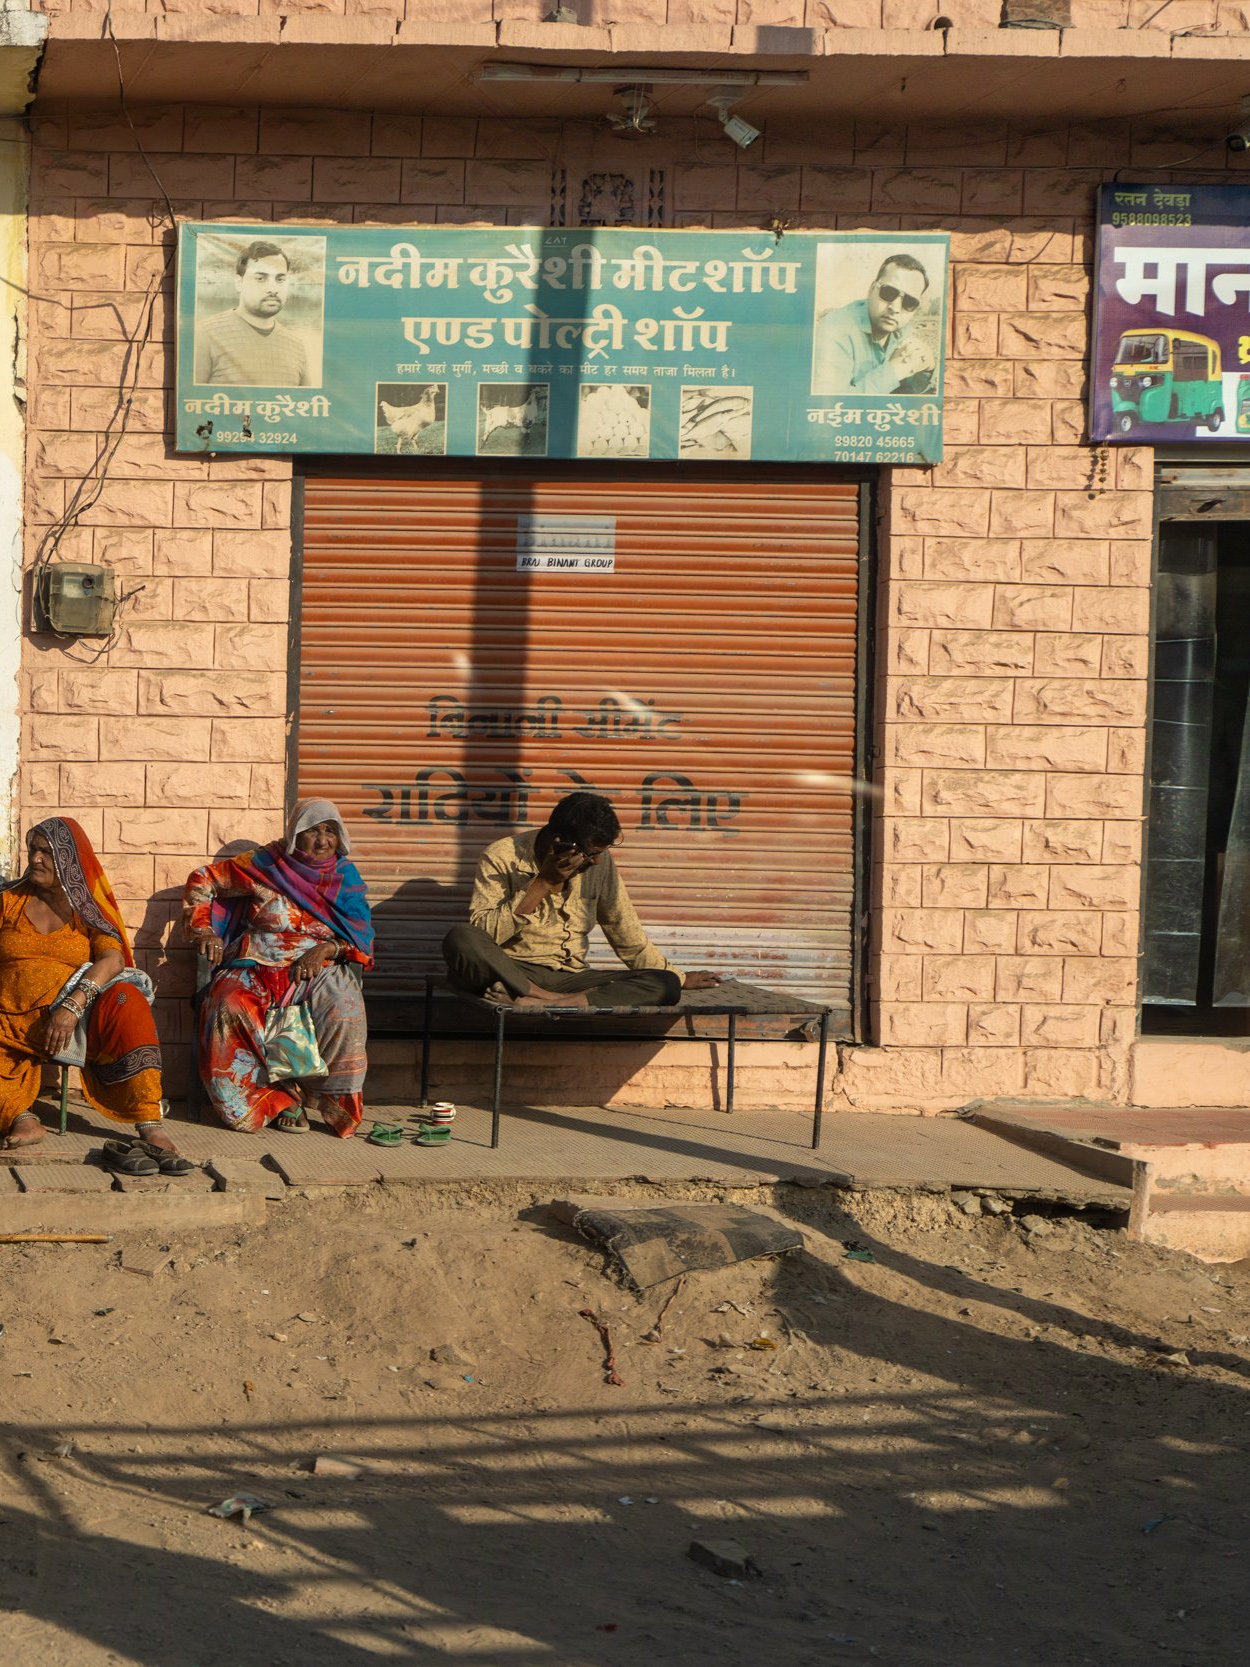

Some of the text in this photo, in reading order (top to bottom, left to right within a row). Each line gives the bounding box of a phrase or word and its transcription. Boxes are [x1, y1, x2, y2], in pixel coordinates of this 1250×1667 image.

[1114, 191, 1147, 206] रतन
[1112, 211, 1192, 227] 9588098523
[336, 242, 801, 305] नदीम कुरैशी मीट शॉप
[401, 303, 733, 360] एण्ड पोल्ट्री शॉप
[396, 361, 422, 374] हमारे
[558, 364, 574, 374] का
[579, 362, 599, 375] मीट
[604, 365, 618, 376] हर
[622, 365, 648, 376] समय
[653, 366, 678, 377] ताजा
[684, 363, 716, 377] मिलता
[183, 393, 331, 423] नदीम कुरैशी
[806, 402, 941, 432] नईम कुरैशी
[258, 432, 298, 444] 32924
[834, 436, 915, 448] 99820 45665
[834, 451, 914, 463] 70147 62216
[584, 558, 613, 568] GROUP
[636, 771, 749, 838] लिए
